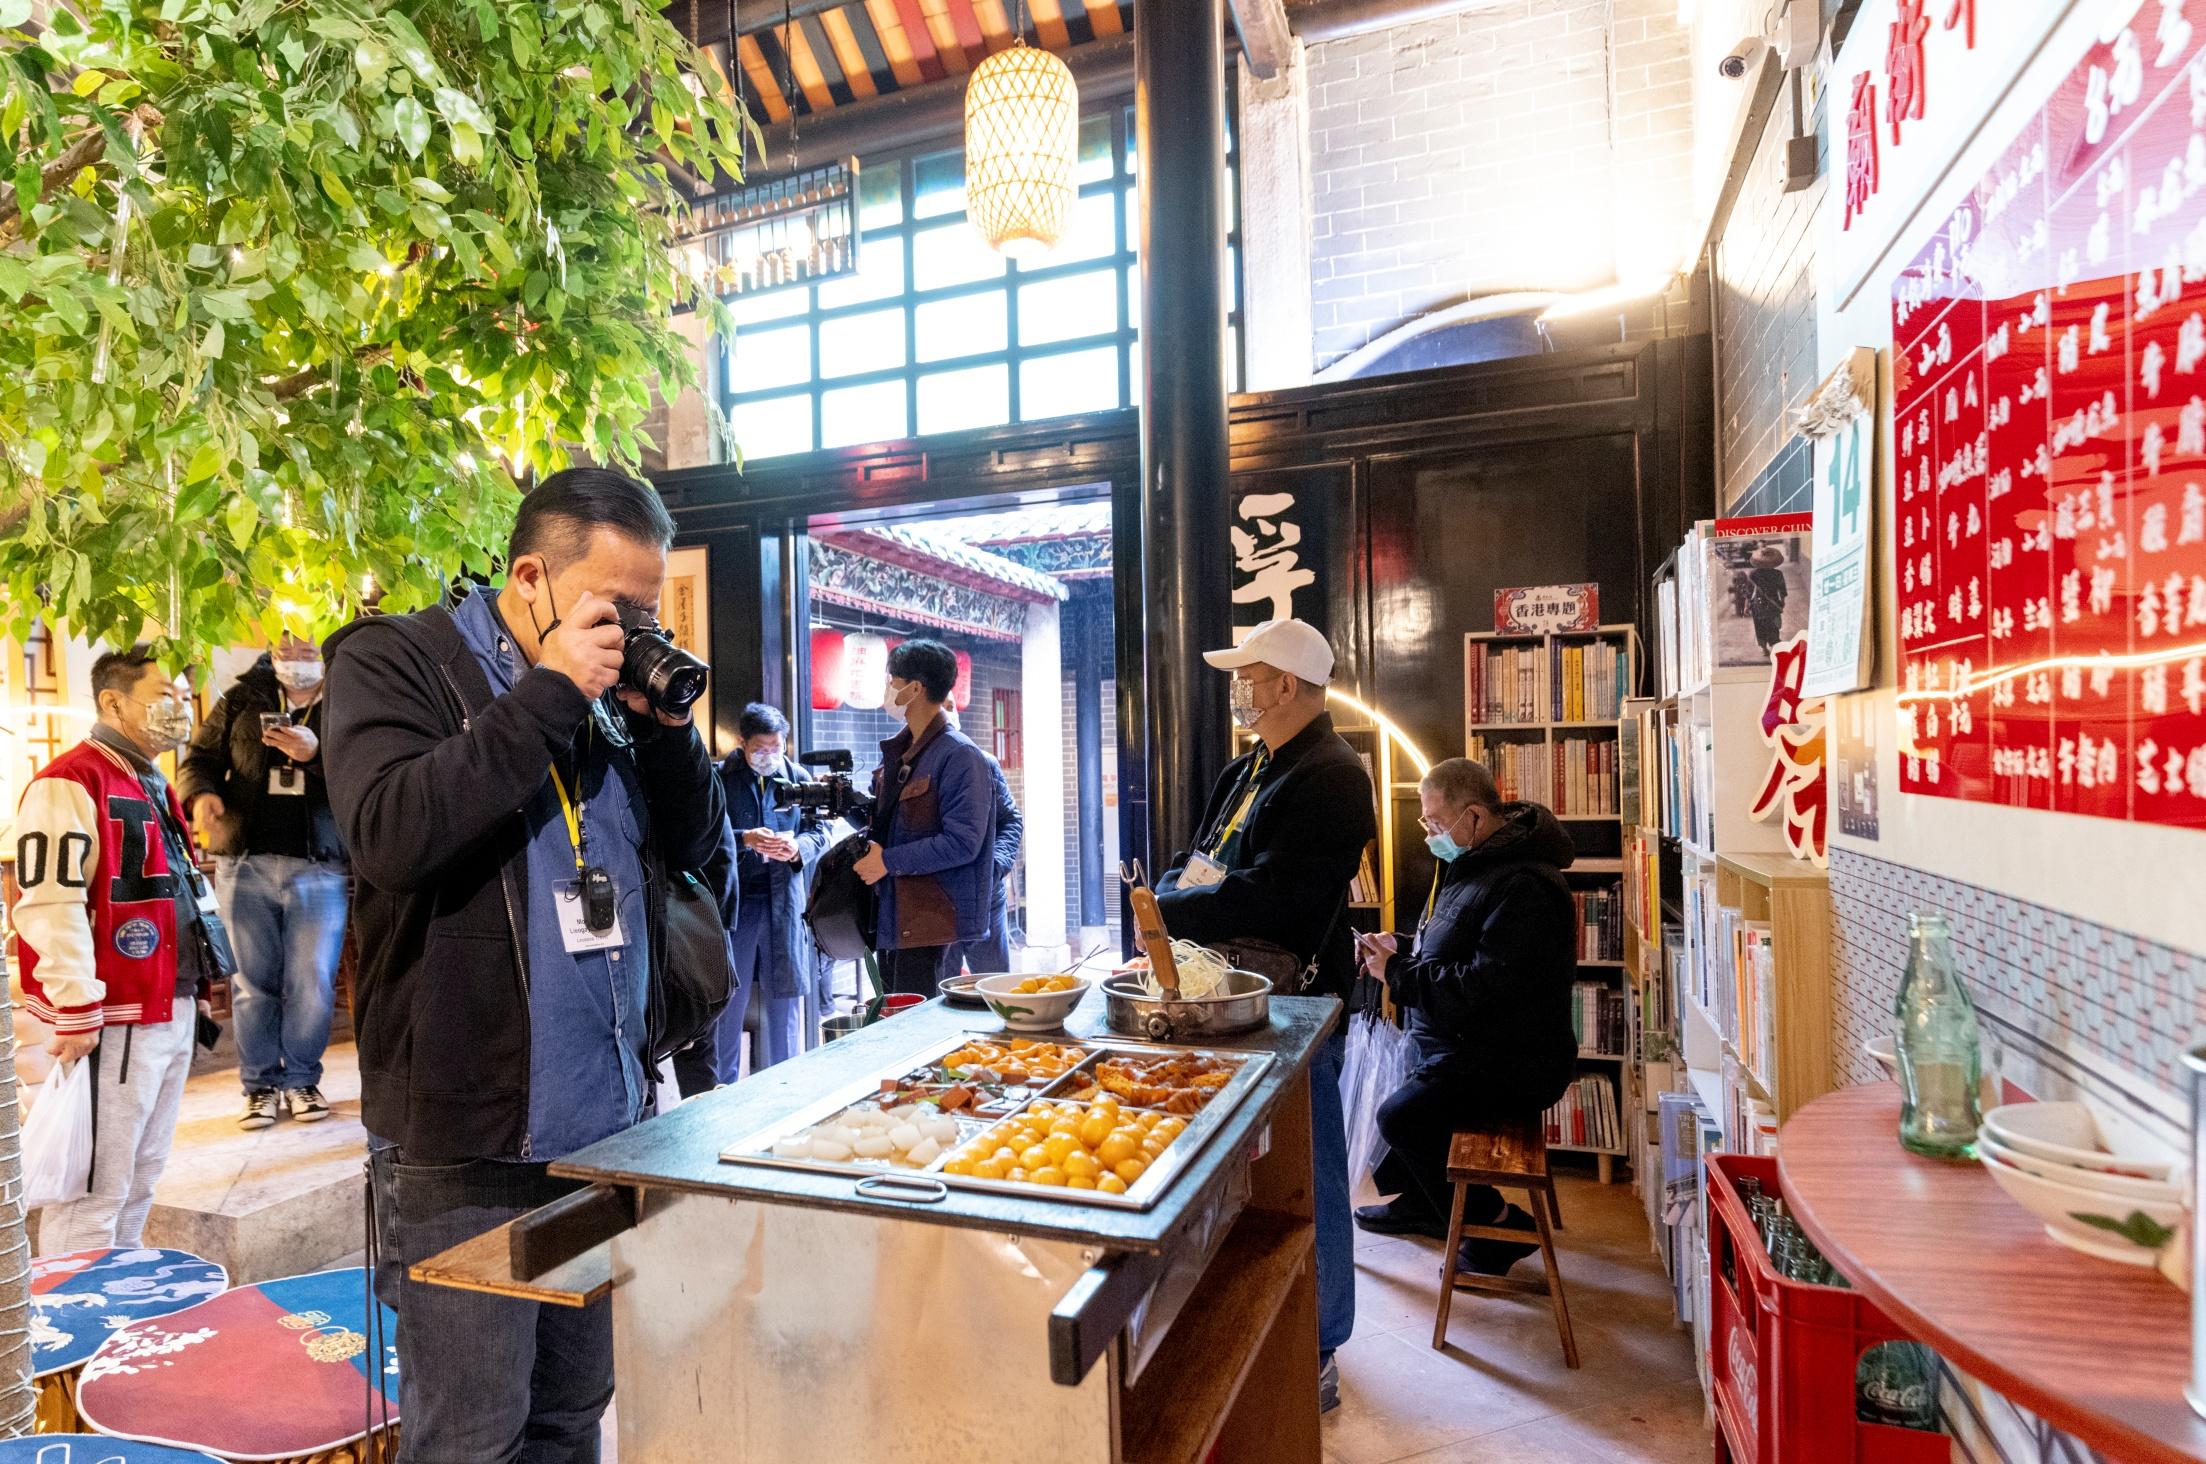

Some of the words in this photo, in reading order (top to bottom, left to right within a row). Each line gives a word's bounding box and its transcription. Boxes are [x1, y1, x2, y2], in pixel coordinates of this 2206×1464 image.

[1828, 415, 1861, 546] 14
[1515, 601, 1576, 618] 香港專題
[17, 831, 92, 889] 00
